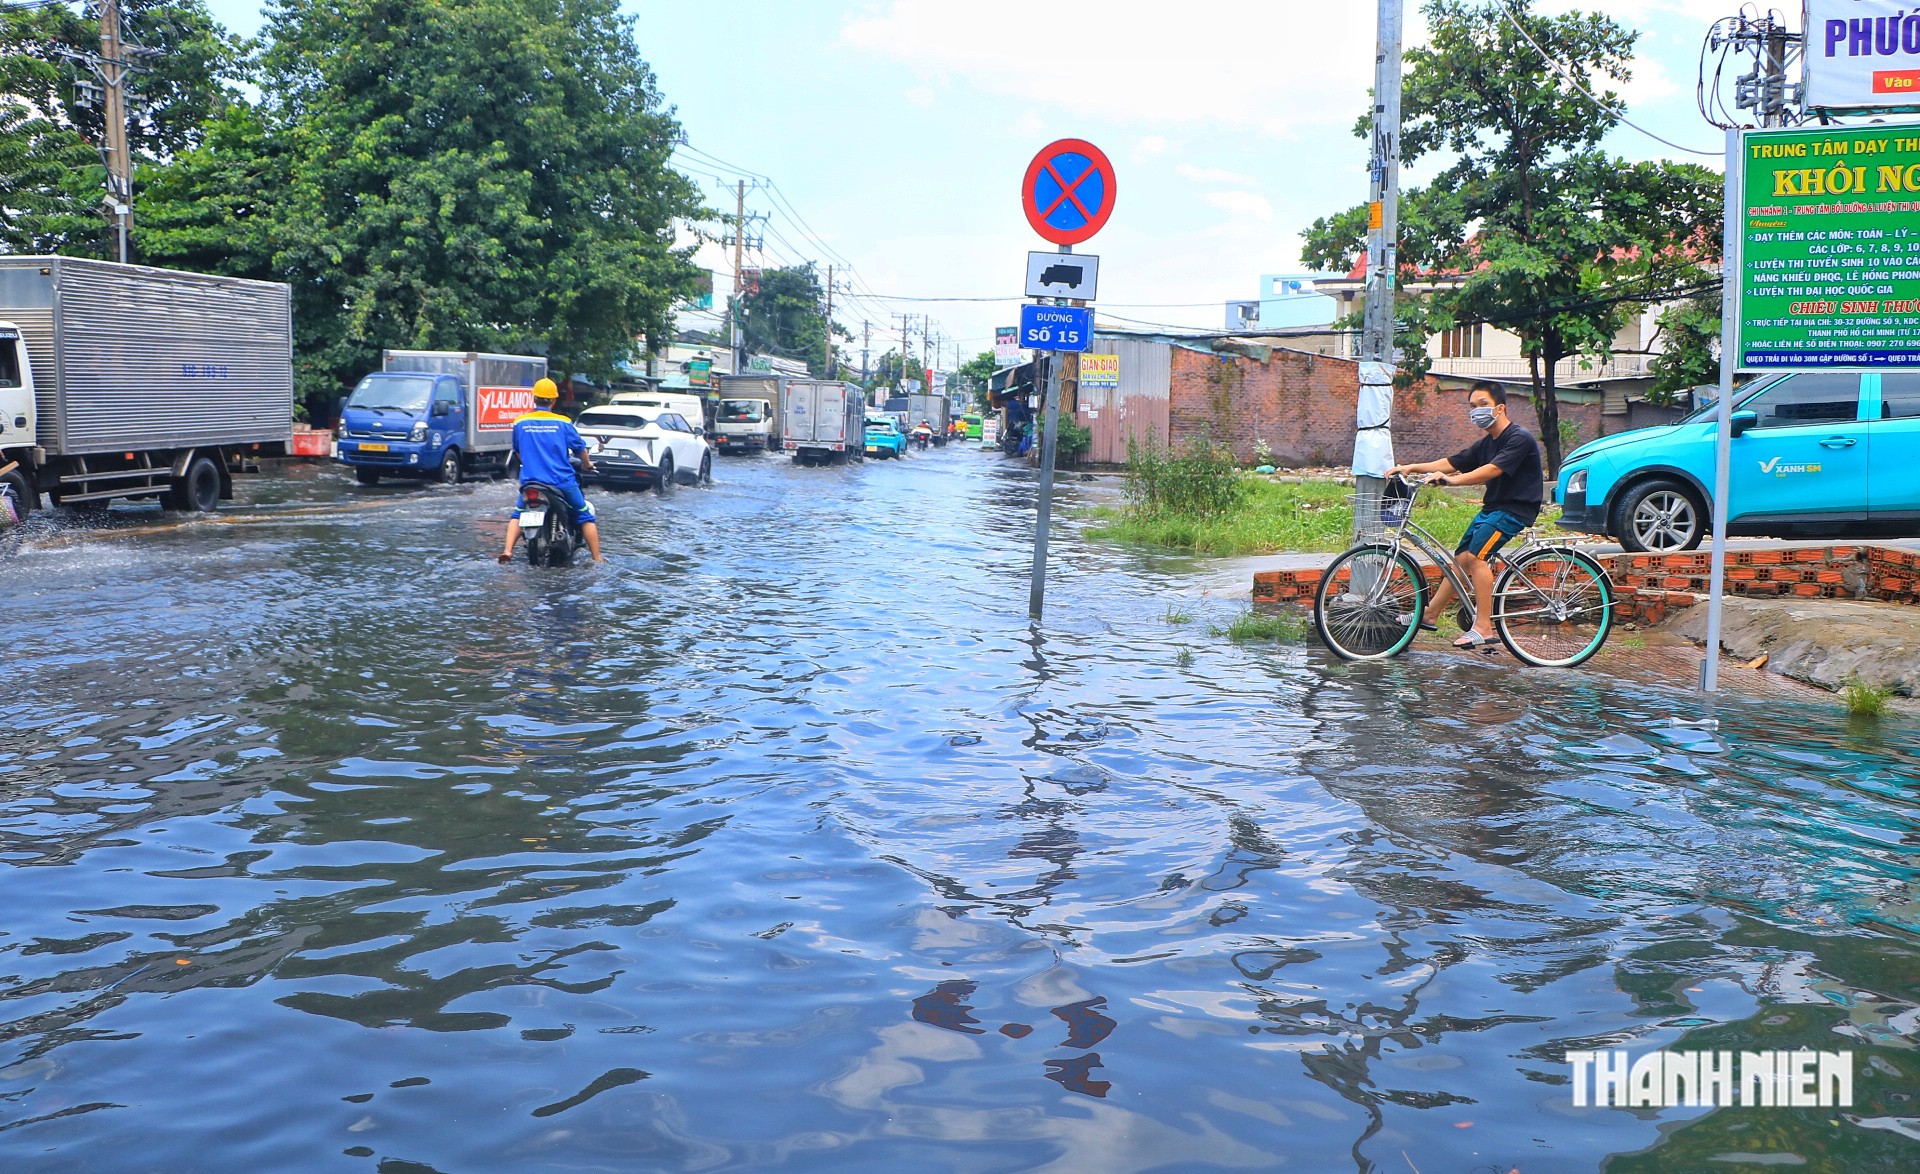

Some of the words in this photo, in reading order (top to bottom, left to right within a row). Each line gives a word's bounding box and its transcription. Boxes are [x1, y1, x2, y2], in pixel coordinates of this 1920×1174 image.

[1884, 77, 1912, 88] Vào
[1751, 143, 1807, 159] TRUNG
[1811, 138, 1848, 156] TÂM
[1853, 139, 1889, 157] DẠY
[1893, 137, 1920, 152] TH
[1772, 159, 1867, 197] KHÔI
[1748, 206, 1760, 217] CHI
[1760, 203, 1783, 217] NHÁNH
[1783, 205, 1788, 215] 1
[1793, 204, 1815, 216] TRUNG
[1815, 202, 1831, 215] TÂM
[1868, 203, 1874, 213] &
[1874, 200, 1897, 214] LUYỆN
[1897, 202, 1910, 212] THI
[1754, 232, 1774, 244] DẠY
[1776, 230, 1804, 241] THÊM
[1806, 229, 1826, 241] CÁC
[1828, 228, 1854, 240] MÔN:
[1856, 228, 1883, 239] TOÁN
[1894, 226, 1908, 238] LÝ
[1808, 243, 1828, 254] CÁC
[1830, 242, 1853, 254] LỚP:
[1855, 244, 1866, 254] 6,
[1868, 243, 1878, 254] 7,
[1880, 243, 1891, 254] 8,
[1893, 243, 1903, 254] 9,
[1754, 257, 1785, 271] LUYỆN
[1787, 259, 1804, 269] THI
[1806, 254, 1838, 268] TUYỂN
[1841, 257, 1864, 267] SINH
[1867, 257, 1880, 267] 10
[1882, 255, 1903, 266] VÀO
[1781, 270, 1811, 282] KHIẾU
[1813, 272, 1844, 283] ĐHQG,
[1846, 270, 1859, 281] LÊ
[1753, 285, 1784, 298] LUYỆN
[1786, 287, 1803, 296] THI
[1805, 286, 1822, 297] ĐẠI
[1825, 286, 1845, 297] HỌC
[1847, 283, 1875, 296] QUỐC
[1876, 285, 1893, 294] GIA
[1789, 298, 1838, 315] CHIÊU
[1840, 300, 1879, 314] SINH
[1882, 298, 1920, 314] THƯ
[1036, 311, 1073, 323] ĐƯỜNG
[1752, 318, 1771, 328] TRỰC
[1773, 316, 1789, 327] TIẾP
[1790, 318, 1802, 328] TẠI
[1803, 318, 1816, 328] ĐỊA
[1833, 318, 1854, 326] 30-32
[1855, 317, 1881, 326] ĐƯỜNG
[1882, 316, 1893, 325] SỐ
[1903, 317, 1919, 325] KDC
[1028, 325, 1053, 342] SỐ
[1057, 330, 1079, 343] 15
[1833, 327, 1848, 337] PHỐ
[1861, 327, 1875, 336] CHÍ
[1875, 328, 1895, 336] MINH
[1751, 339, 1772, 349] HOẶC
[1774, 339, 1791, 348] LIÊN
[1793, 339, 1804, 349] HỆ
[1805, 338, 1817, 348] SỐ
[1818, 339, 1837, 349] ĐIỆN
[1838, 340, 1864, 349] THOẠI:
[1866, 340, 1886, 348] 0907
[1746, 355, 1763, 364] QUẸO
[1764, 354, 1780, 363] TRÁI
[1789, 354, 1803, 363] VÀO
[1803, 355, 1818, 363] 30M
[1833, 354, 1857, 362] ĐƯỜNG
[1857, 353, 1868, 362] SỐ
[1887, 354, 1906, 363] QUẸO
[490, 391, 537, 409] LALAMOV
[1775, 465, 1805, 473] XANH
[1806, 464, 1821, 473] SM
